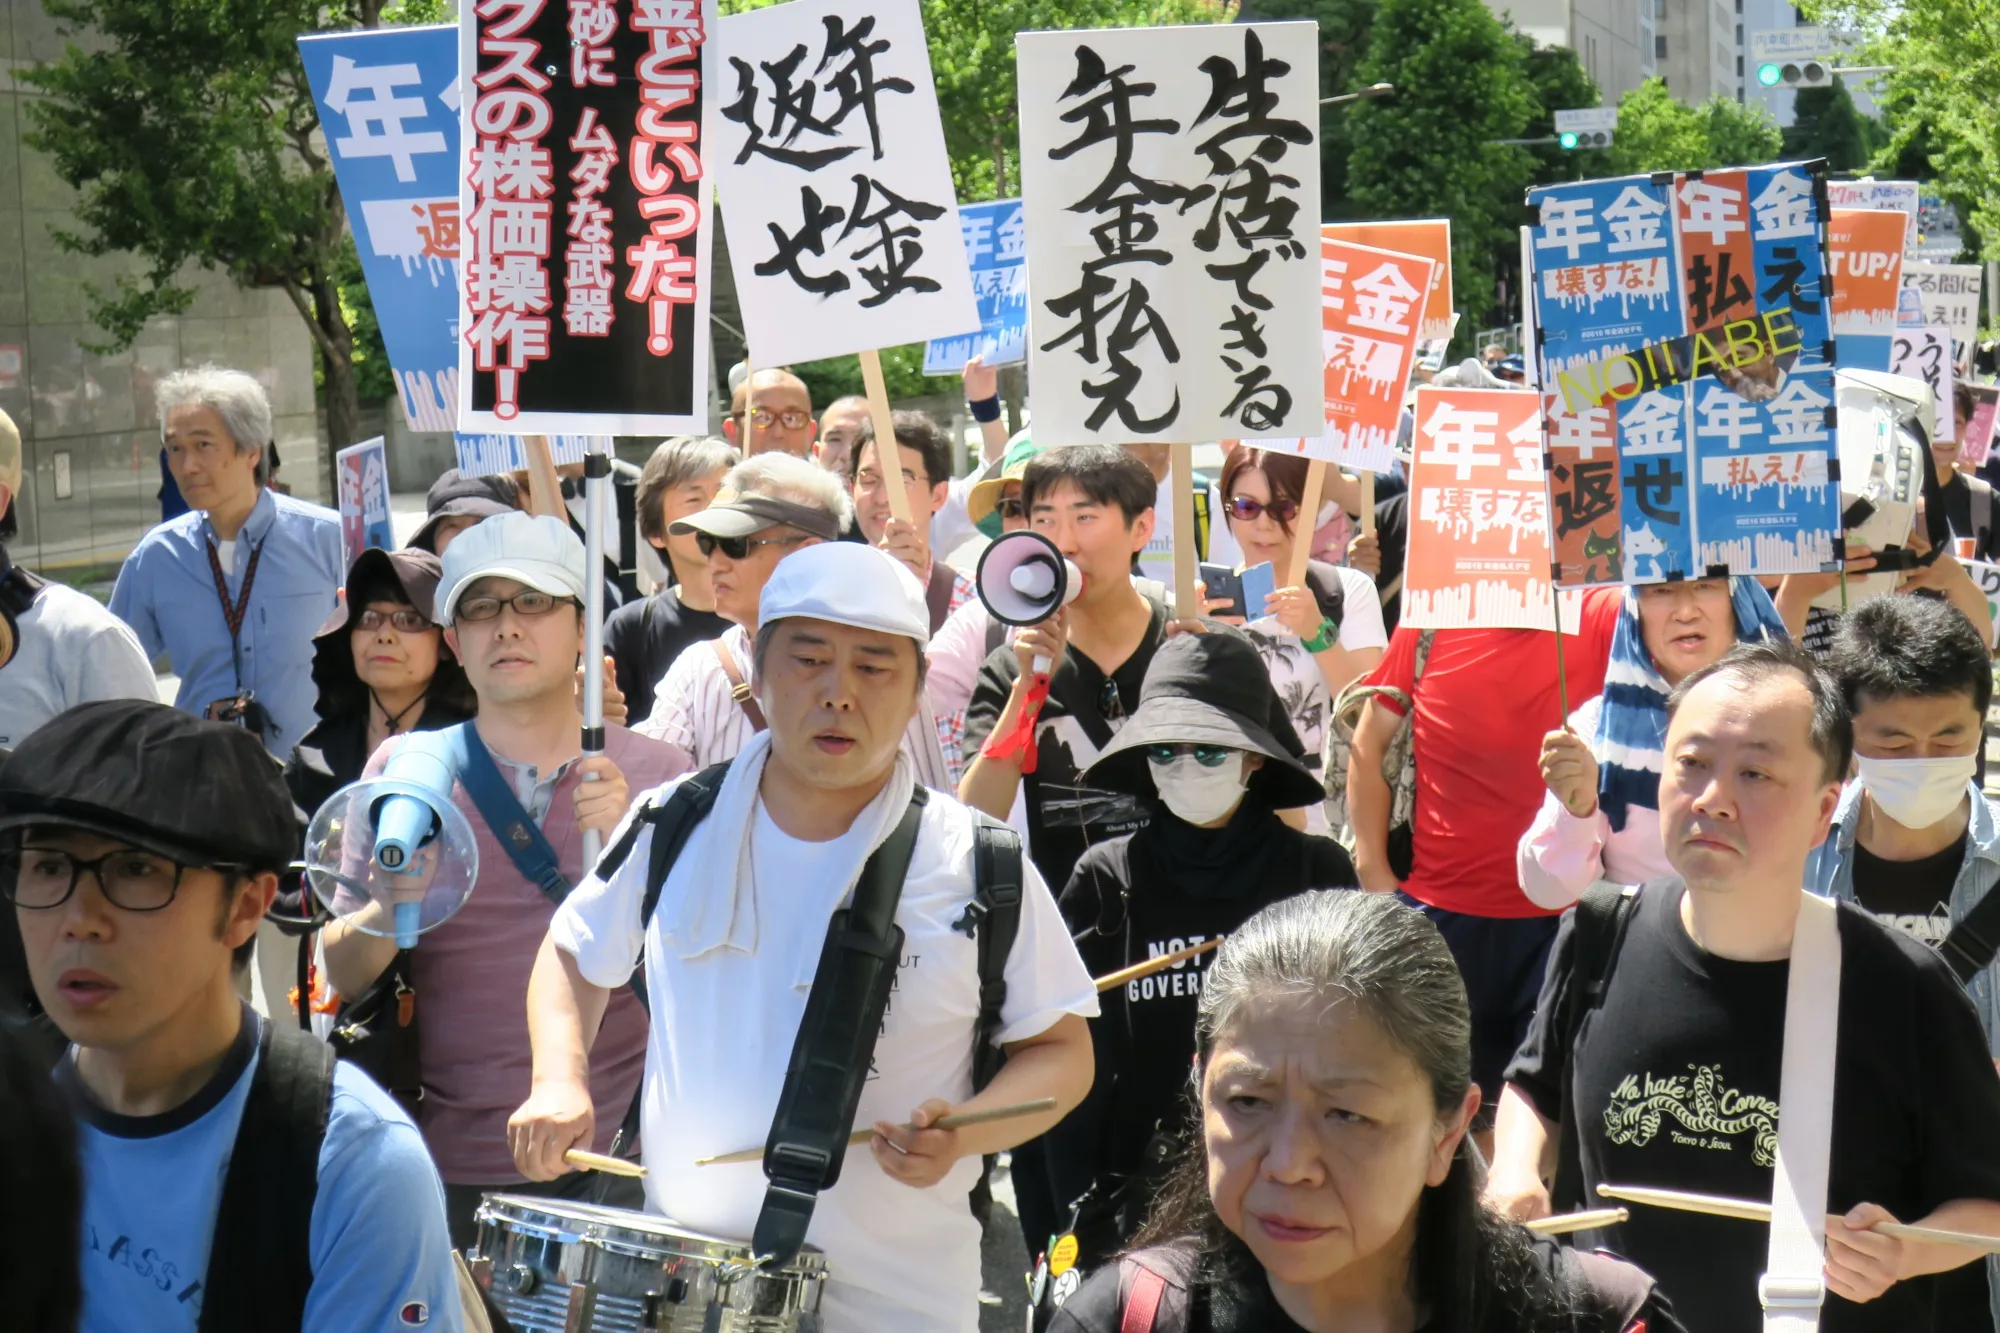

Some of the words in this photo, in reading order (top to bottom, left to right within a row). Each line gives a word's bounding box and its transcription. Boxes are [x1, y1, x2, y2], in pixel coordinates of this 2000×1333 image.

[567, 0, 618, 87] 砂に
[324, 55, 459, 182] 年
[720, 43, 865, 300] 返せ
[814, 15, 947, 307] 年金
[466, 0, 554, 420] クスの株価操作!
[564, 107, 618, 336] ムダな武器
[1040, 45, 1182, 434] 年金払え
[1177, 27, 1313, 431] 生活できる
[1536, 185, 1668, 259] 年金
[1679, 169, 1815, 245] 年金
[1555, 258, 1657, 295] 壊すな!
[1687, 247, 1821, 329] 払え
[1848, 251, 1900, 281] UP!
[1690, 307, 1802, 381] ABE
[1924, 305, 1968, 325] え!!
[1323, 336, 1380, 374] え!
[1547, 388, 1683, 460] 年金
[1697, 380, 1830, 449] 年金
[1554, 458, 1684, 541] 返せ
[1727, 453, 1804, 487] 払え!
[1149, 936, 1205, 971] NOT
[1611, 1074, 1641, 1098] No
[1644, 1072, 1685, 1099] hate
